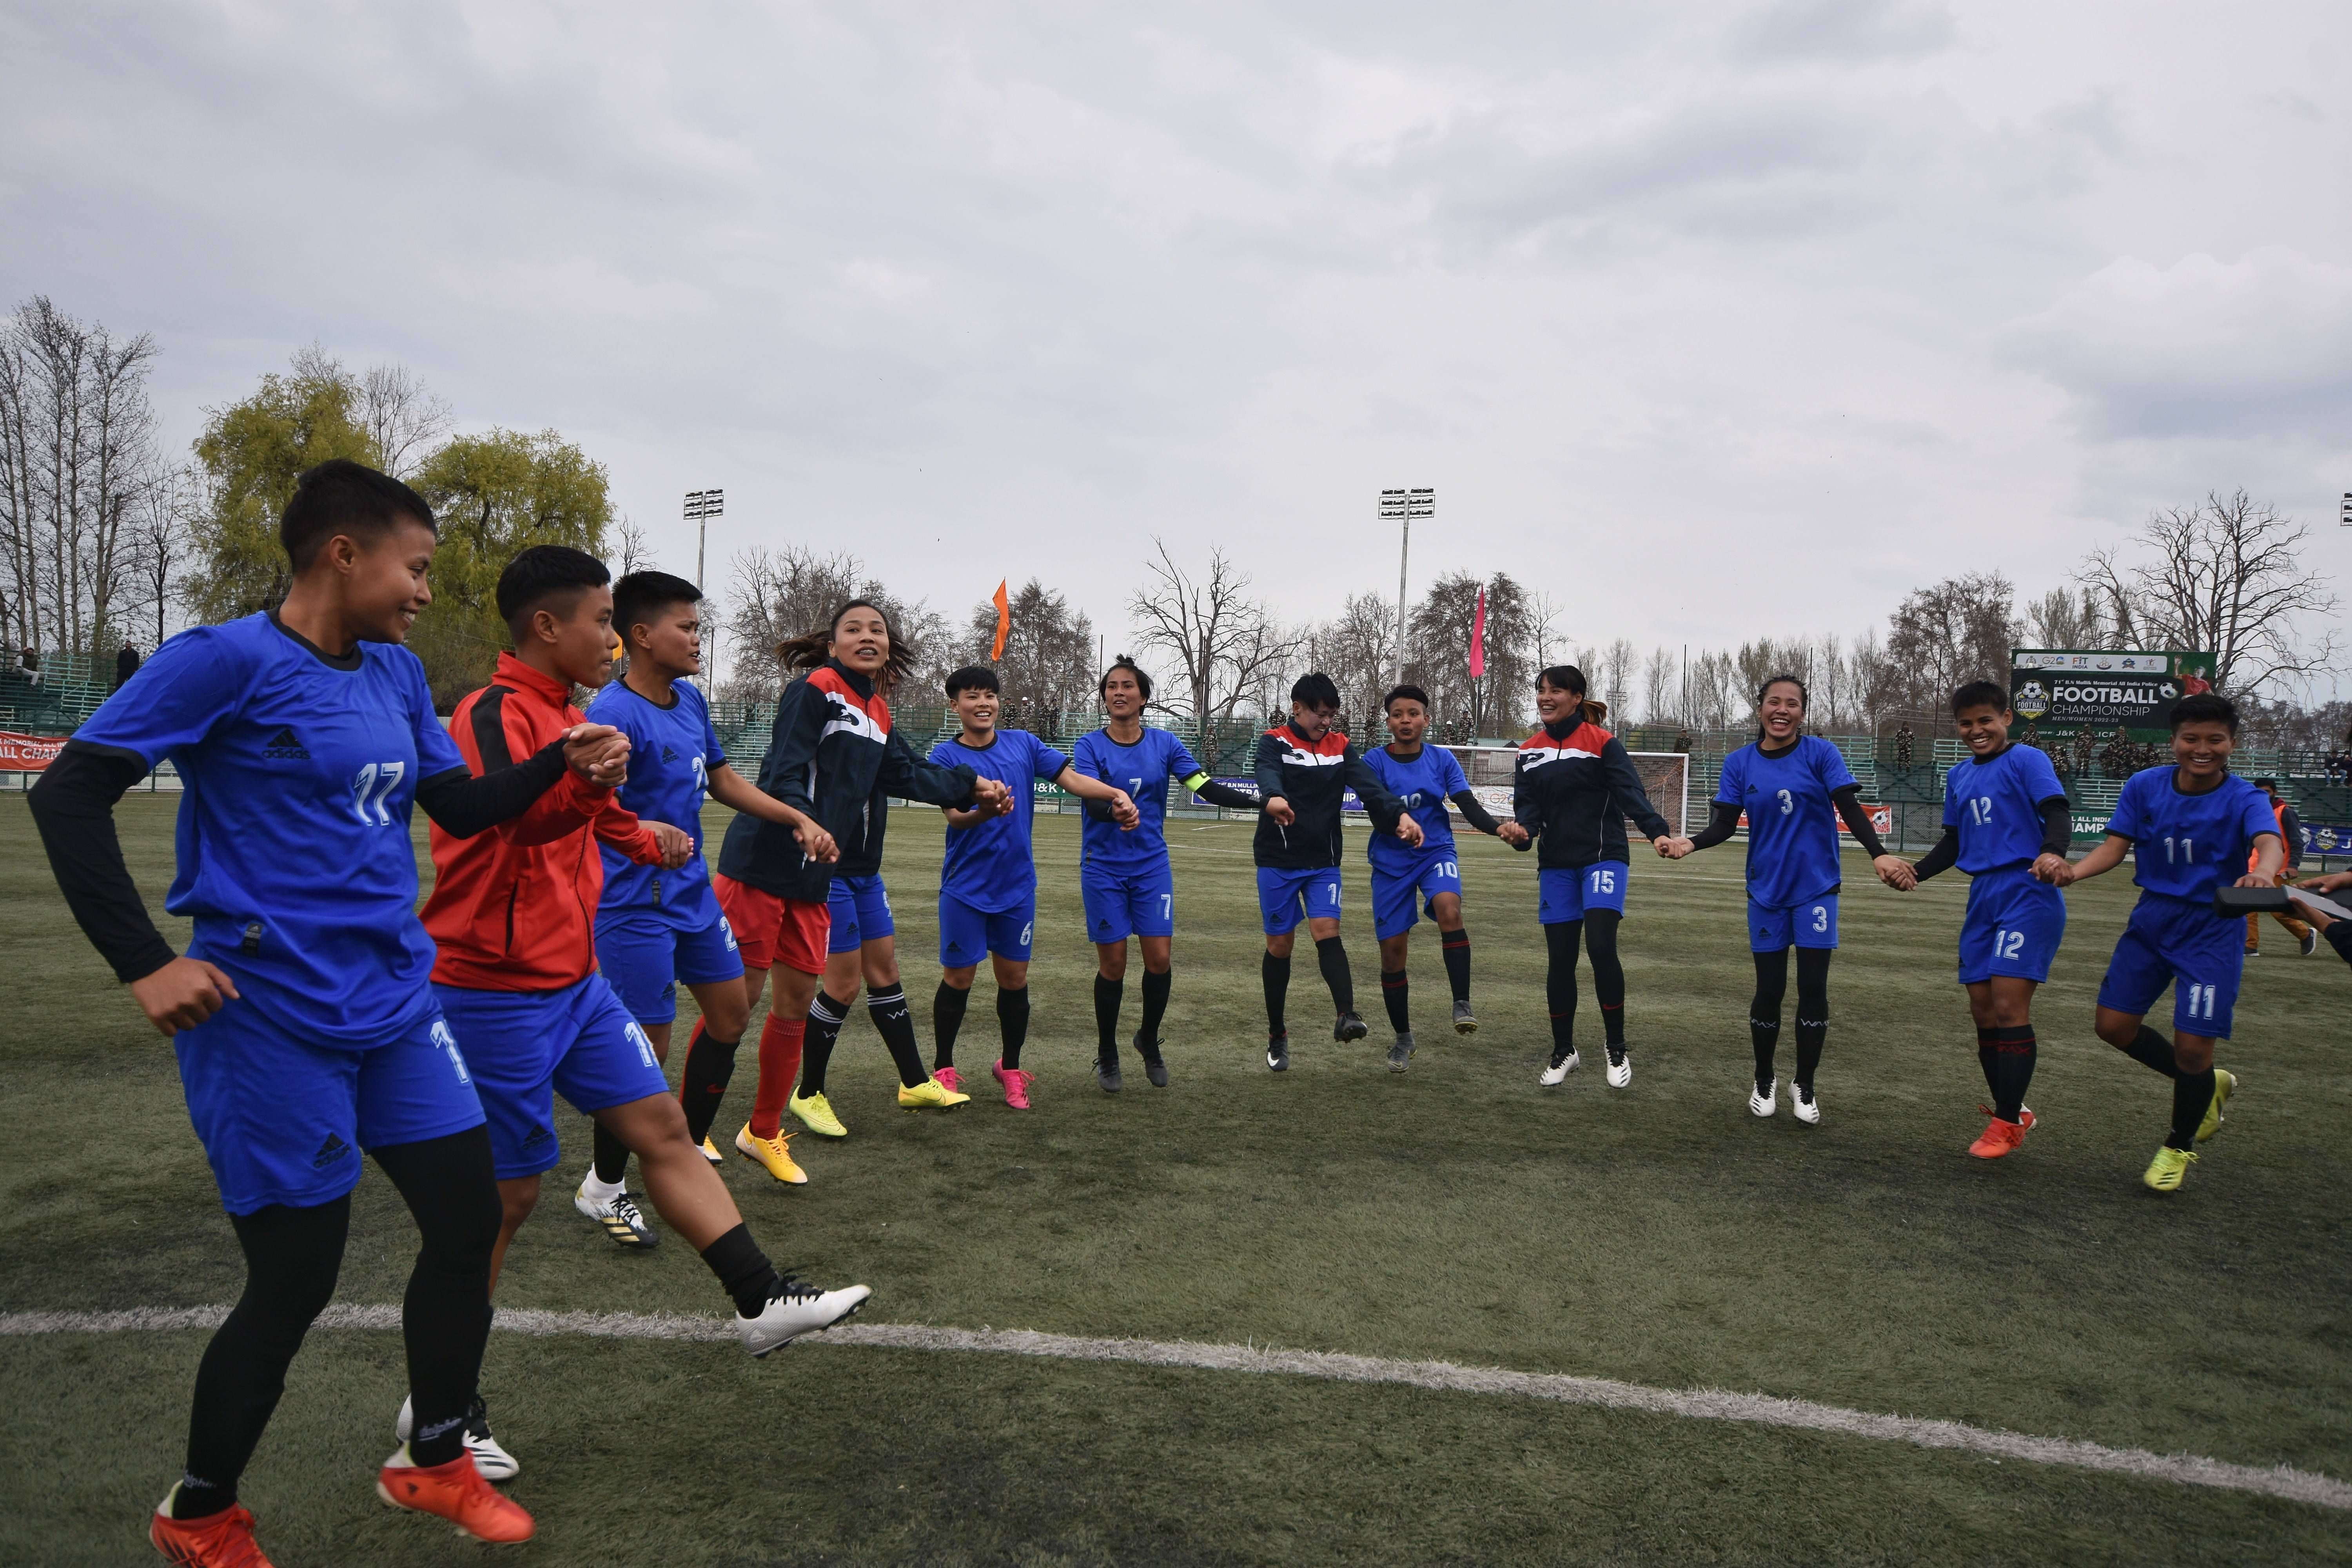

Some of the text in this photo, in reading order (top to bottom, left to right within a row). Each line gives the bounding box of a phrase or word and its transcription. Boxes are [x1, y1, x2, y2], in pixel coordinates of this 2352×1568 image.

[2053, 687, 2158, 704] FOOTBALL
[2053, 704, 2150, 716] CHAMPIONSHIP
[4, 739, 42, 747] MEMORIAL
[262, 748, 311, 760] adidas
[354, 761, 404, 826] 17
[1129, 778, 1141, 800] 7
[1401, 793, 1421, 809] 10
[1777, 789, 1793, 815] 3
[1970, 797, 1992, 826] 12
[2164, 837, 2193, 864] 11
[1433, 862, 1458, 878] 10
[1591, 870, 1614, 894] 15
[1161, 894, 1171, 920] 7
[1328, 883, 1342, 908] 1
[1813, 906, 1827, 933] 3
[1020, 921, 1032, 946] 6
[1994, 931, 2024, 960] 12
[2188, 983, 2215, 1020] 11
